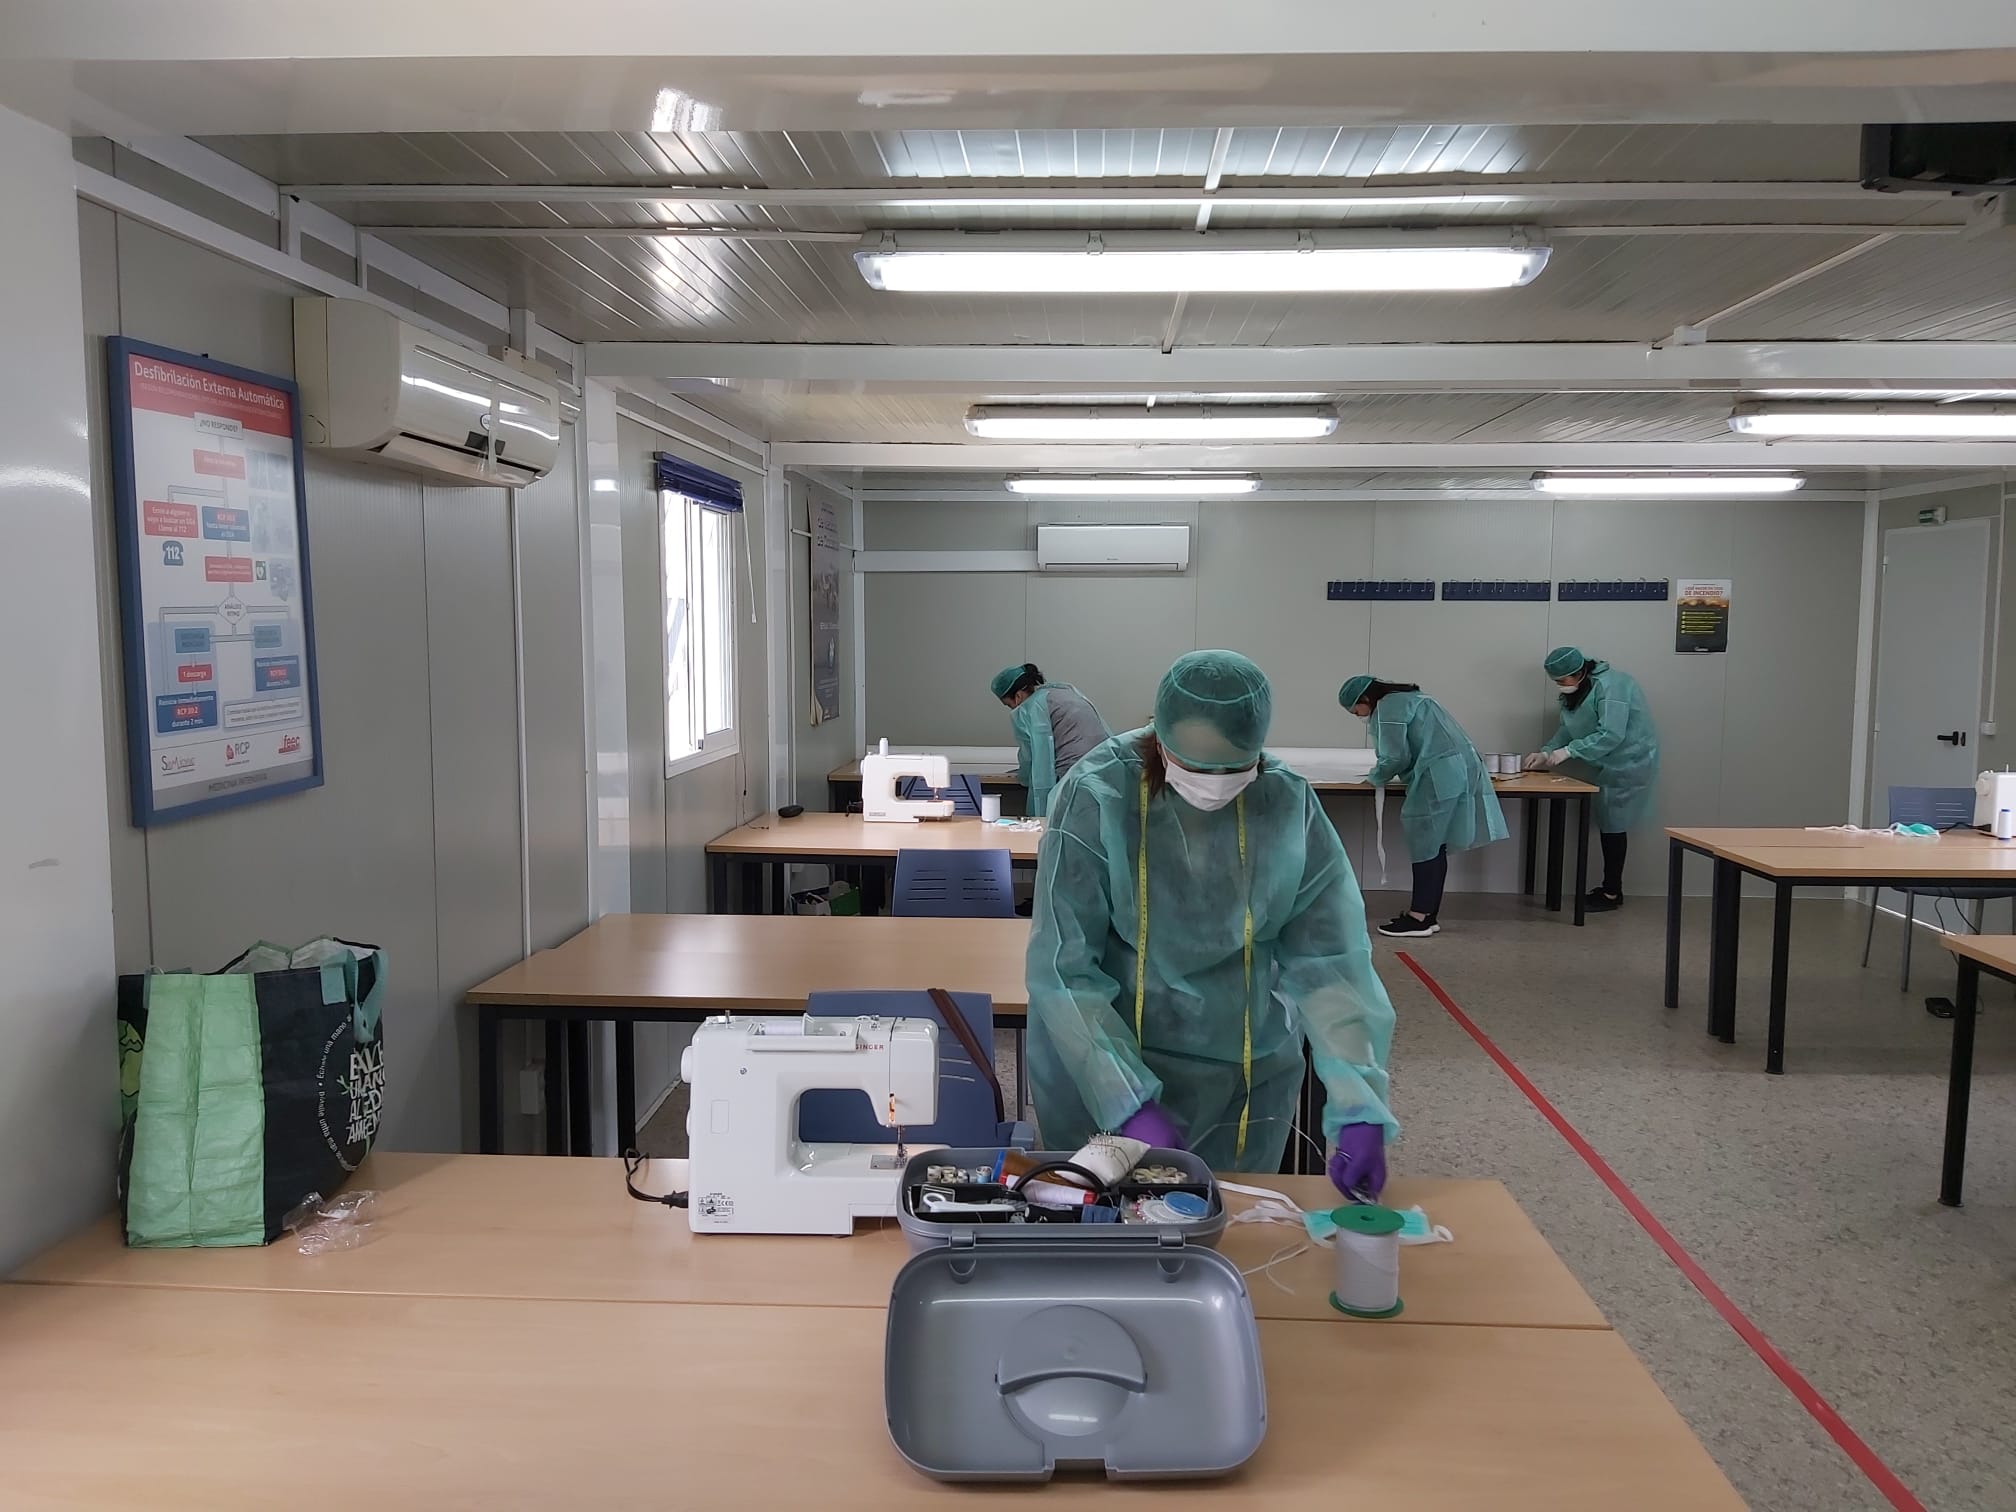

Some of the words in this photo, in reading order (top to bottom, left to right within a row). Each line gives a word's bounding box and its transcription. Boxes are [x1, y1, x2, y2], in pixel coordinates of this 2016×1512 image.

[134, 361, 201, 390] Desfibrilación
[203, 378, 236, 398] Externa
[238, 387, 285, 410] Automática
[165, 546, 180, 561] 112
[331, 1021, 347, 1041] mano
[319, 1118, 331, 1138] unha
